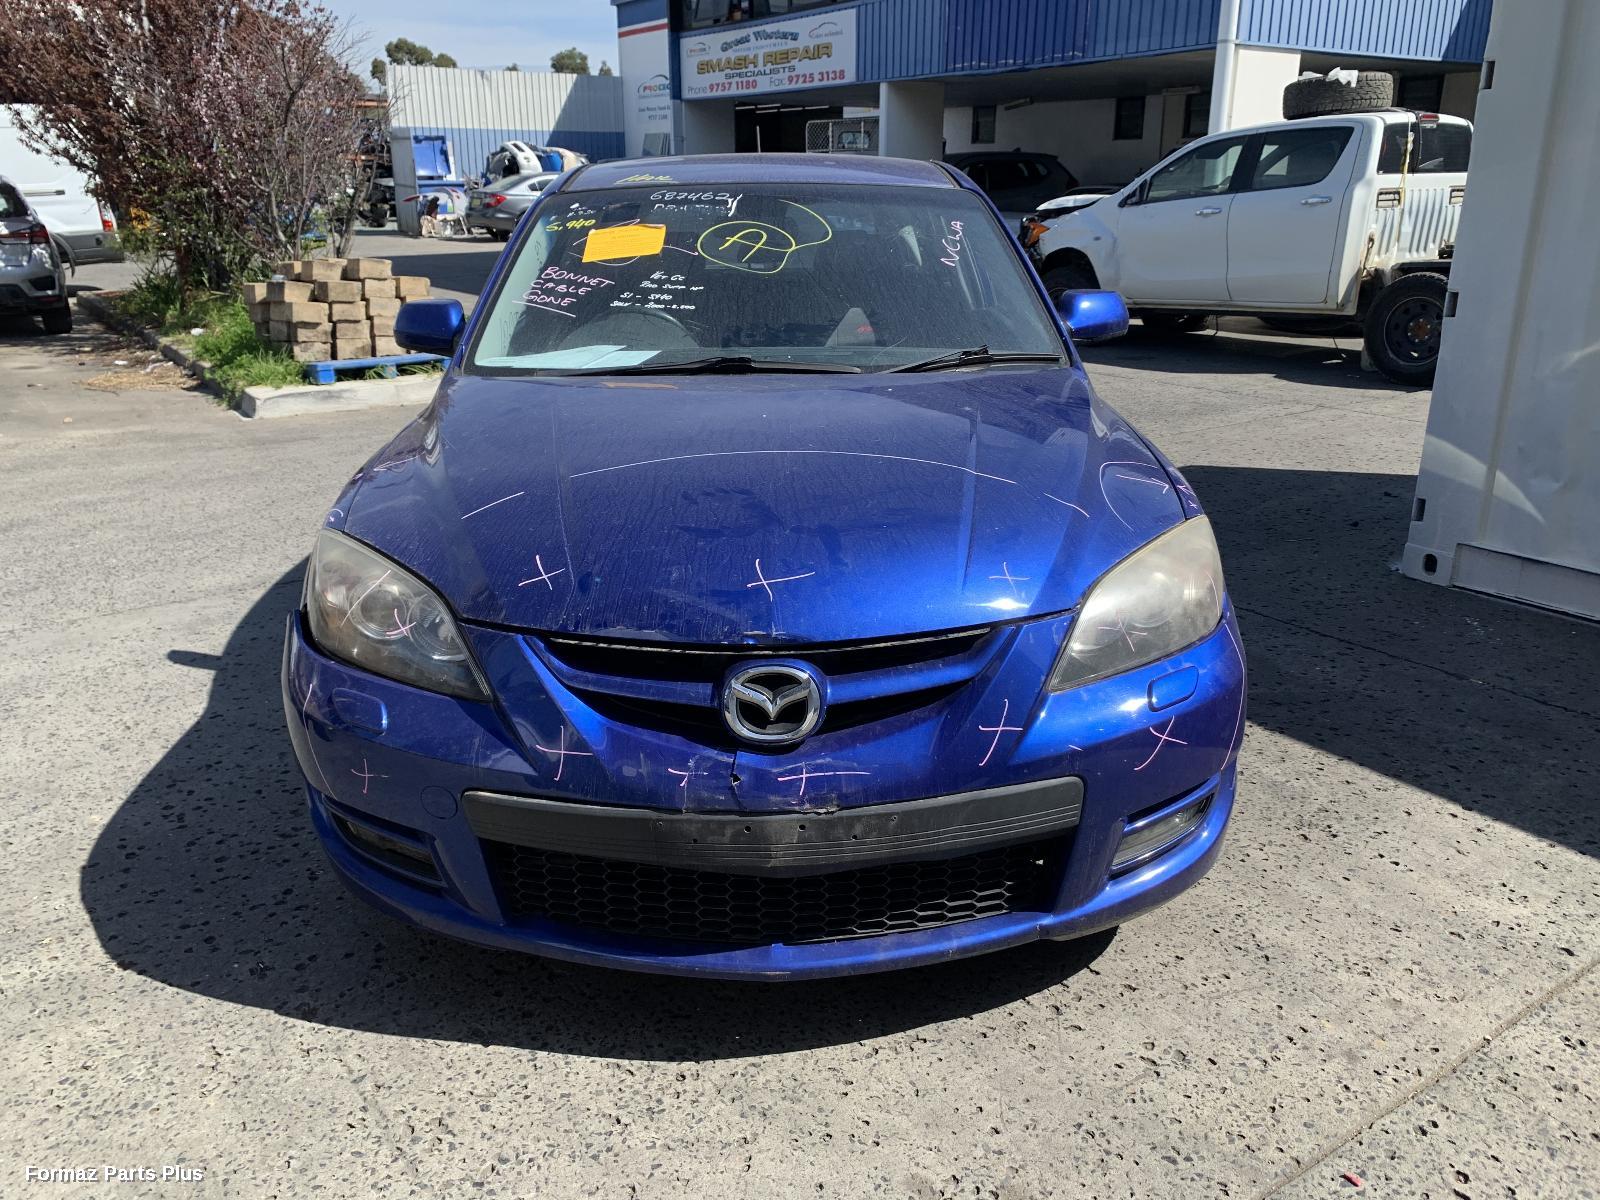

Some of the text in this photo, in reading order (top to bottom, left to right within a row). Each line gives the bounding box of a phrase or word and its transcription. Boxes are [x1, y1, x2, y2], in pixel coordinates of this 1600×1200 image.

[720, 33, 751, 53] Great
[696, 53, 759, 76] SMASH
[763, 42, 834, 68] REPAIR
[708, 81, 734, 93] 9757
[736, 79, 758, 91] 1180
[787, 73, 816, 86] 9725
[818, 69, 846, 82] 3138
[724, 65, 797, 80] SPECIALISTS
[530, 279, 593, 295] CABLE
[541, 266, 616, 288] BONNET
